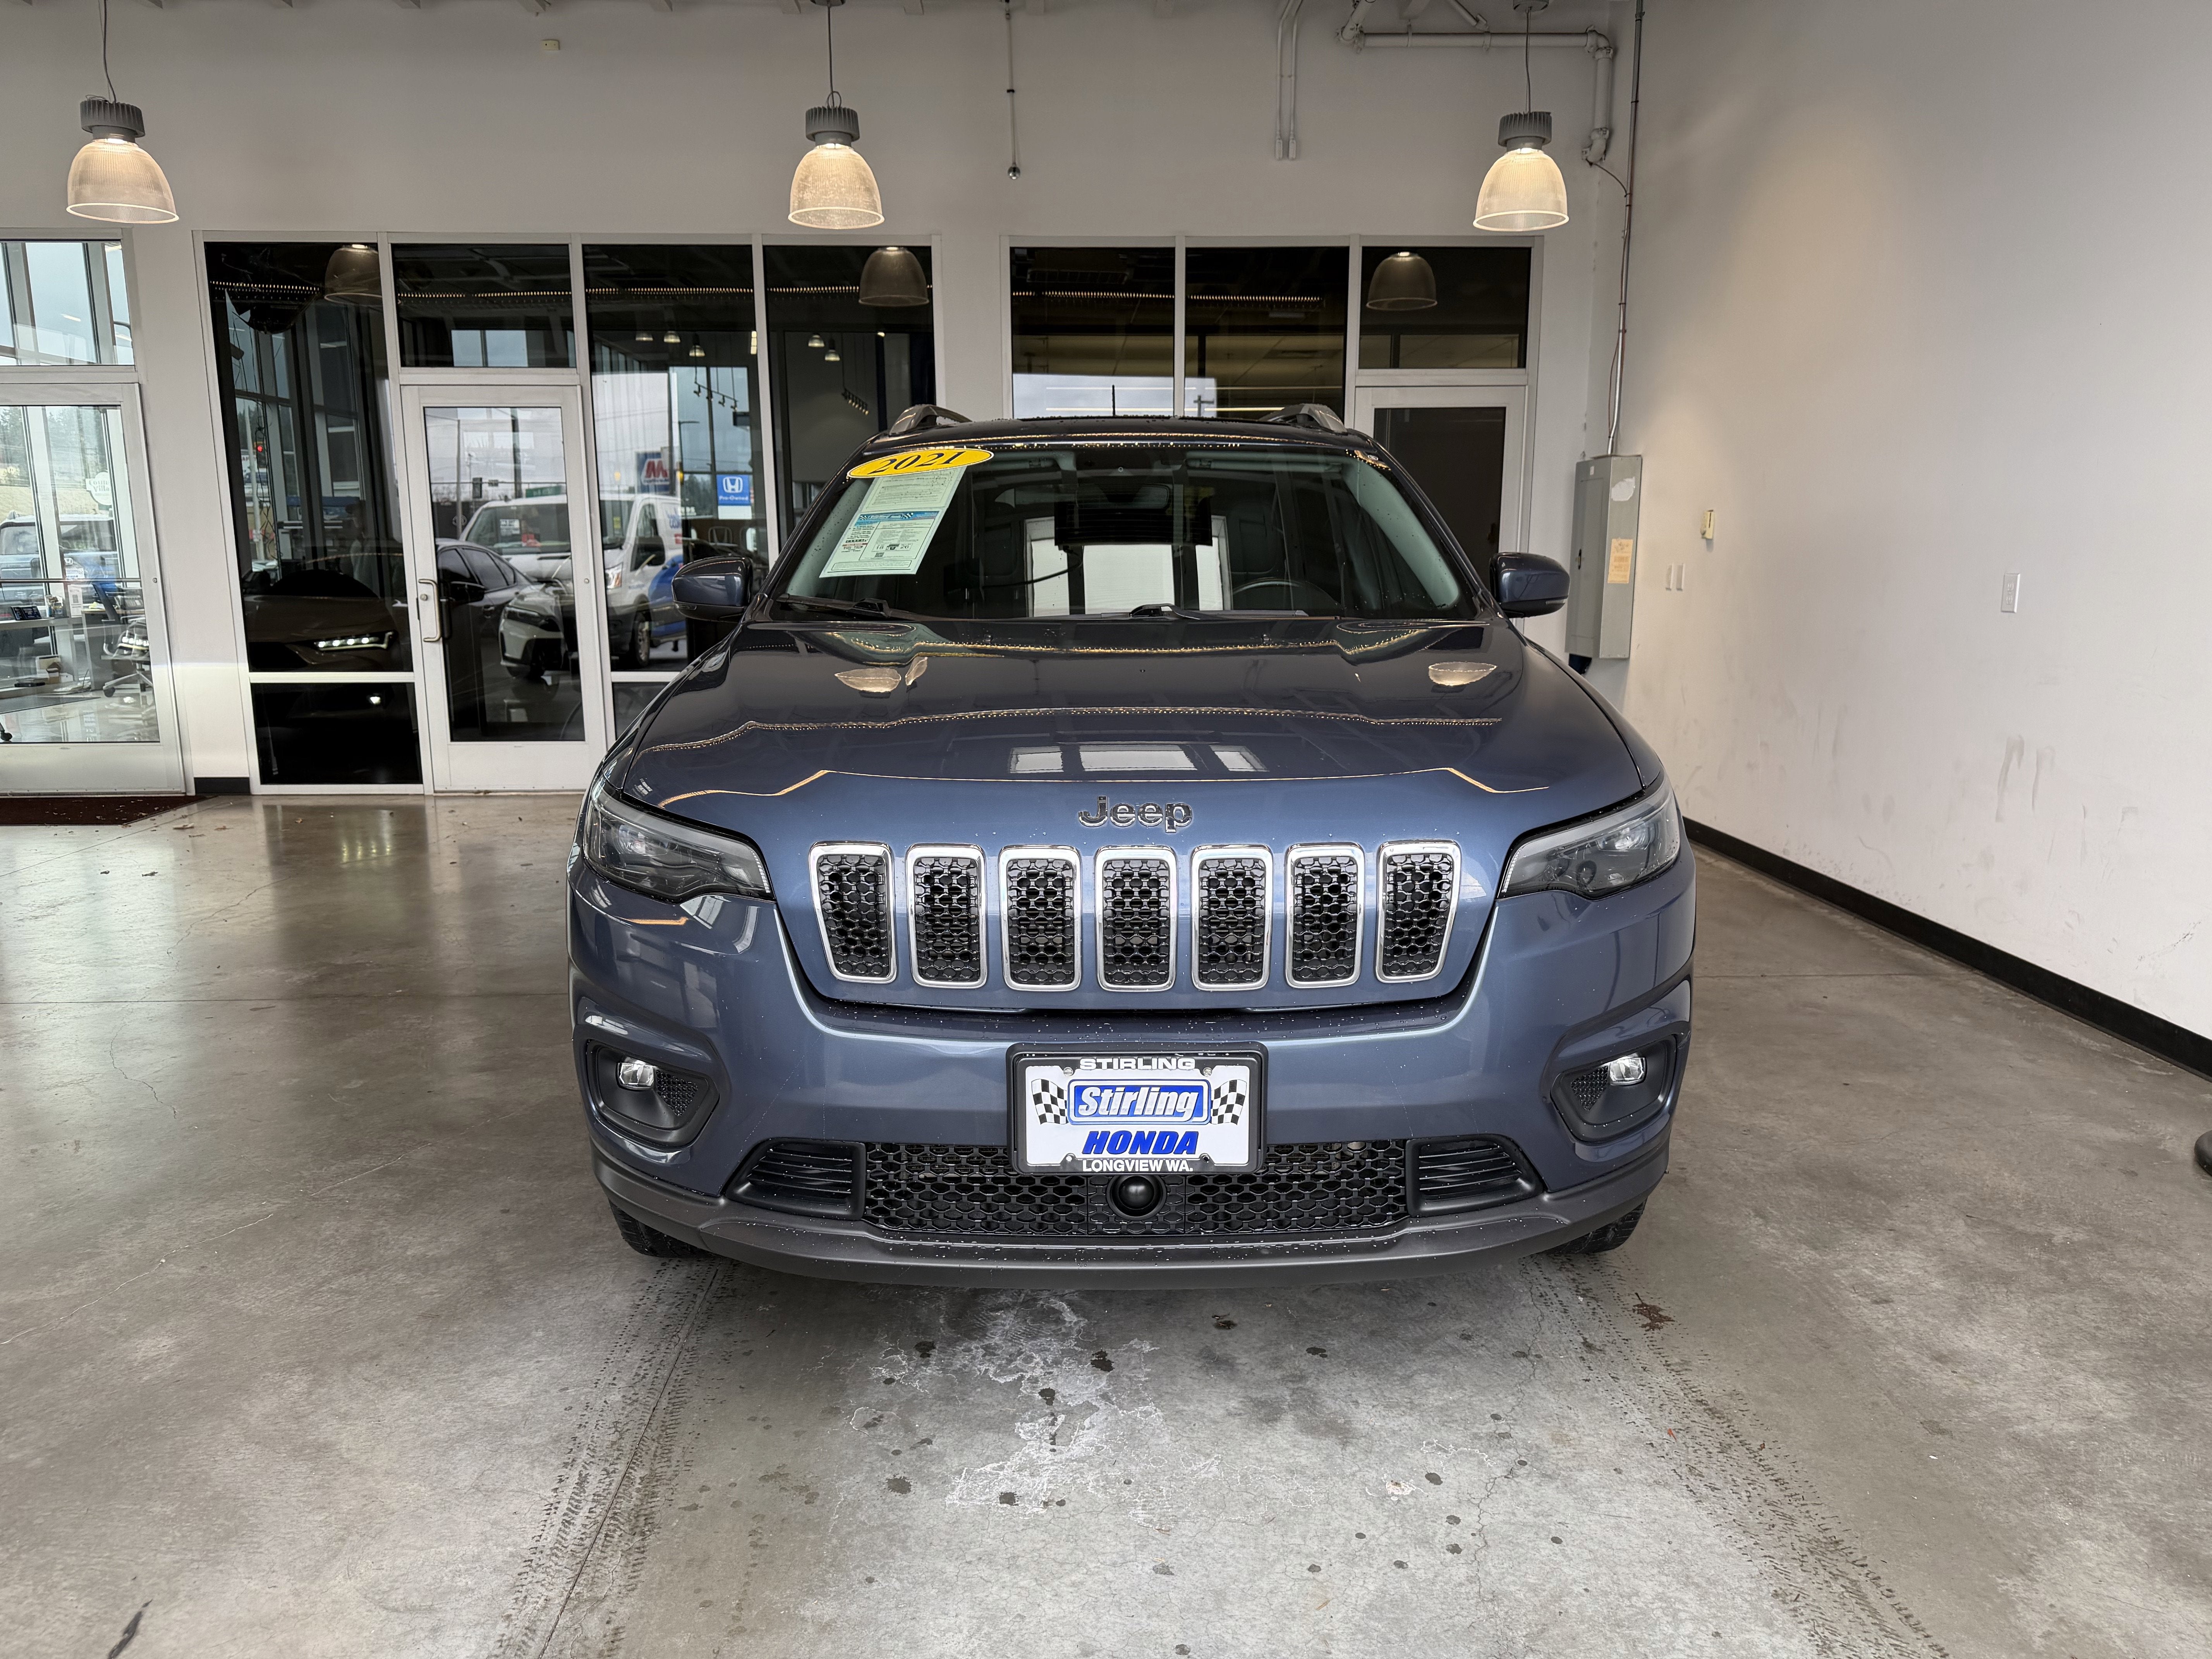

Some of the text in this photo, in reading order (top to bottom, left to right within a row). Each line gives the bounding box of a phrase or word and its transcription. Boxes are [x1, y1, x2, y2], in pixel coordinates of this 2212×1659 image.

[867, 451, 966, 474] 2021
[1079, 795, 1192, 833] Jeep
[1080, 1058, 1195, 1070] STIRLING
[1078, 1086, 1199, 1119] Stirling
[1082, 1131, 1199, 1155] HONDA
[1082, 1160, 1193, 1172] LONGVIEW WA.
